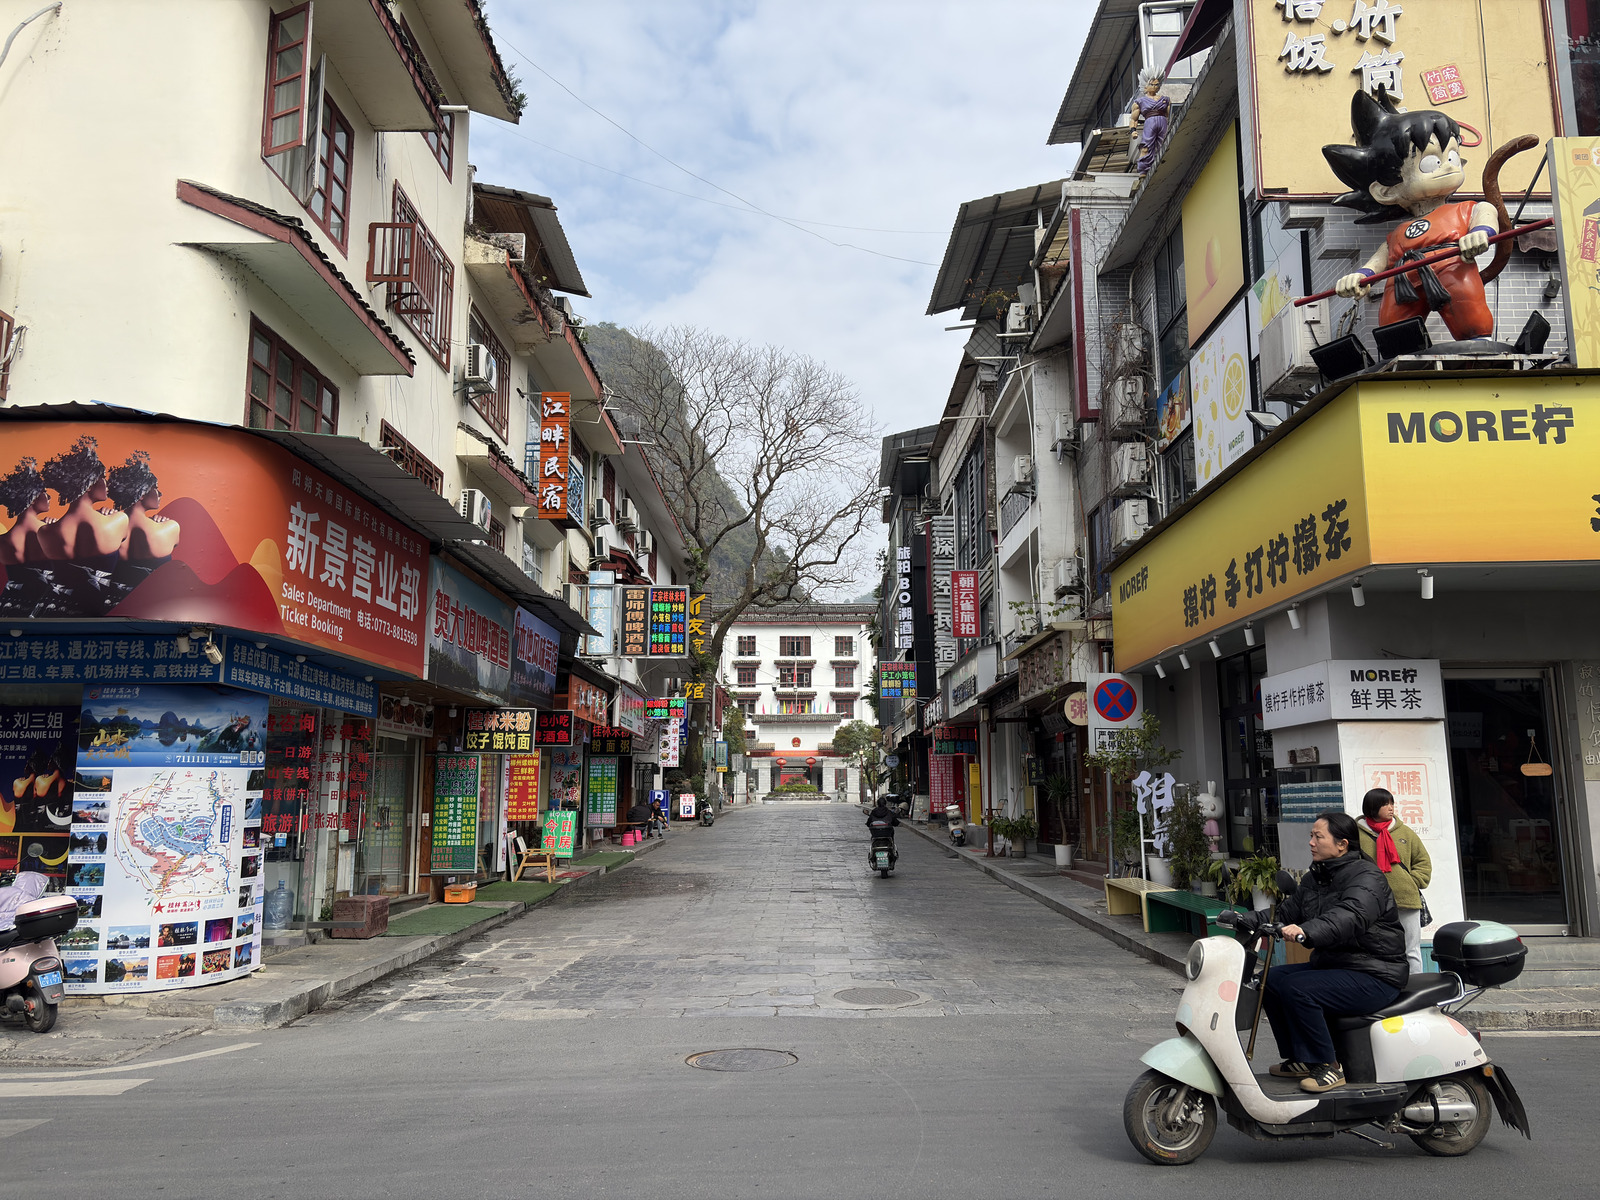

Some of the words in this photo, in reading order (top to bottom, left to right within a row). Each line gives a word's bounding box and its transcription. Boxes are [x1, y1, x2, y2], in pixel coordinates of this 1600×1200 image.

[1387, 403, 1575, 445] MORE柠
[541, 396, 567, 512] 江畔民宿
[292, 468, 422, 558] 阳朔天顺国际旅行社有限责任公司
[286, 501, 421, 622] 新景营业部
[1224, 498, 1352, 609] 手打柠檬茶
[1119, 565, 1149, 603] MORE柠
[282, 582, 305, 604] Sales
[307, 591, 352, 621] Department
[652, 591, 685, 602] 正宗桂林米粉
[959, 577, 976, 635] 朝云雀旅拍
[652, 613, 671, 622] 小笼包
[672, 613, 684, 622] 炒饭
[672, 603, 684, 612] 炒粉
[280, 604, 308, 627] Ticket
[311, 615, 344, 642] Booking
[357, 609, 418, 646] 电话:0773-8815598
[433, 588, 510, 671] 贺大姐啤酒鱼
[624, 588, 646, 655] 雷师傅啤酒鱼
[652, 623, 671, 632] 牛肉面
[882, 672, 915, 680] 手工小笼包
[1350, 668, 1418, 683] MORE柠
[1350, 688, 1423, 710] 鲜果茶
[0, 711, 64, 728] ·刘三姐
[468, 711, 532, 731] 桂林米粉
[536, 714, 569, 727] 色小吃
[19, 730, 47, 740] SANJIE
[48, 730, 62, 738] LIU
[466, 732, 490, 749] 饺子
[492, 732, 531, 750] 馄饨面
[268, 745, 312, 759] 一日游
[513, 767, 535, 775] 三鲜粉
[1371, 769, 1422, 796] 红糖
[684, 806, 691, 814] P
[1397, 800, 1425, 824] 茶
[545, 819, 572, 832] 今日
[543, 835, 572, 848] 有房
